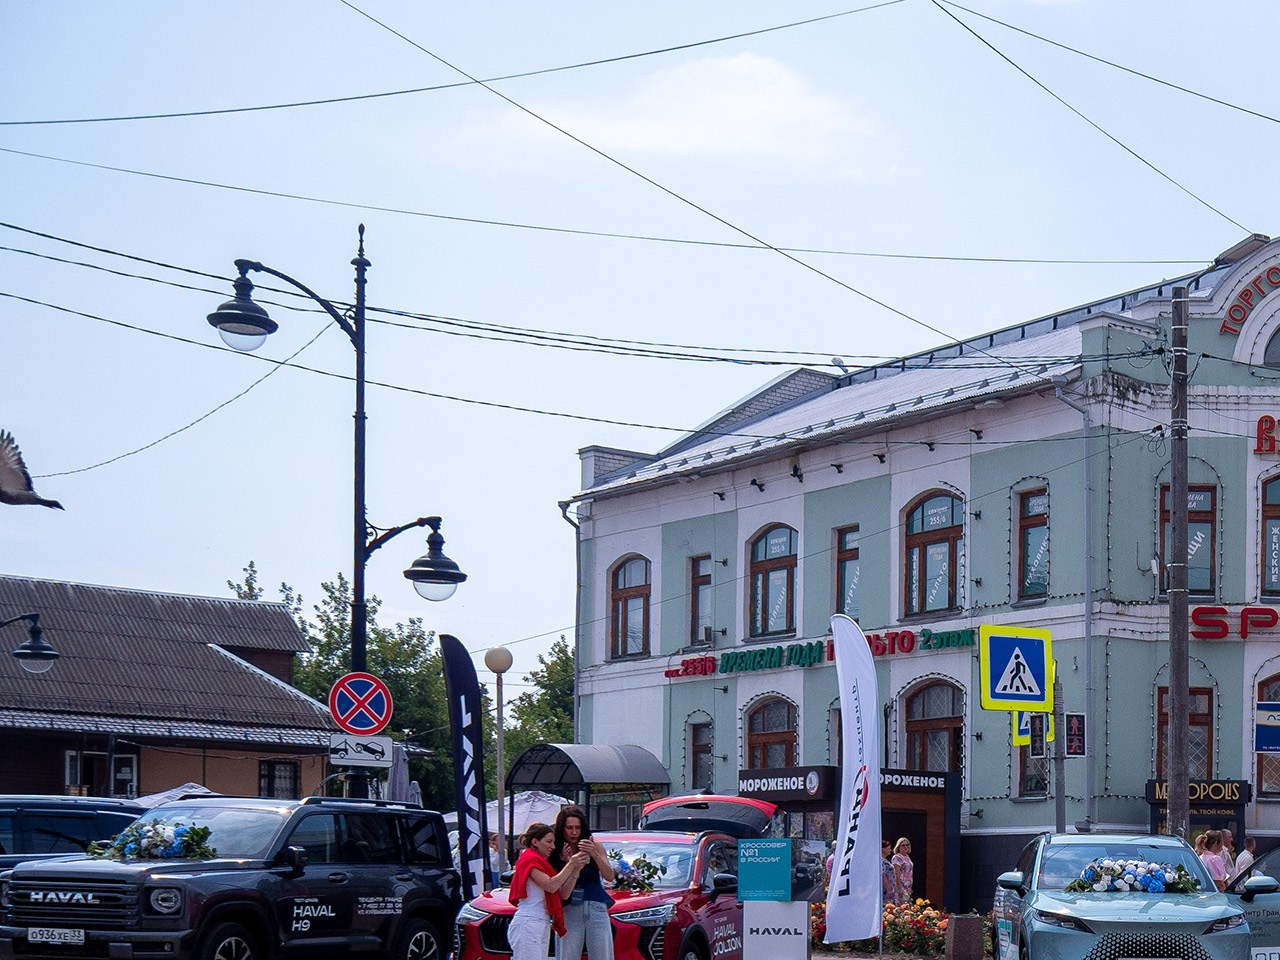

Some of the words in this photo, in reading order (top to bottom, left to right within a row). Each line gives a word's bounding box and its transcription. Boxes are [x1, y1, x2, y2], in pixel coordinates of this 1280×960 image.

[1271, 527, 1280, 582] ЖЕНСКИЕ
[719, 645, 784, 674] ВРЕМЕНА
[785, 640, 824, 668] ГОДА
[739, 776, 804, 792] МОРОЖЕНОЕ
[879, 774, 945, 788] ОРОЖЕНОЕ
[1155, 782, 1240, 800] MEOPOLIS
[1200, 808, 1217, 816] ТВОЙ
[740, 848, 759, 857] №1
[30, 891, 101, 905] HAVAL
[293, 905, 337, 917] HAVAL
[291, 919, 311, 932] H9
[713, 922, 737, 939] HAVAL
[749, 927, 803, 936] HAVAL
[713, 936, 742, 956] JOLION
